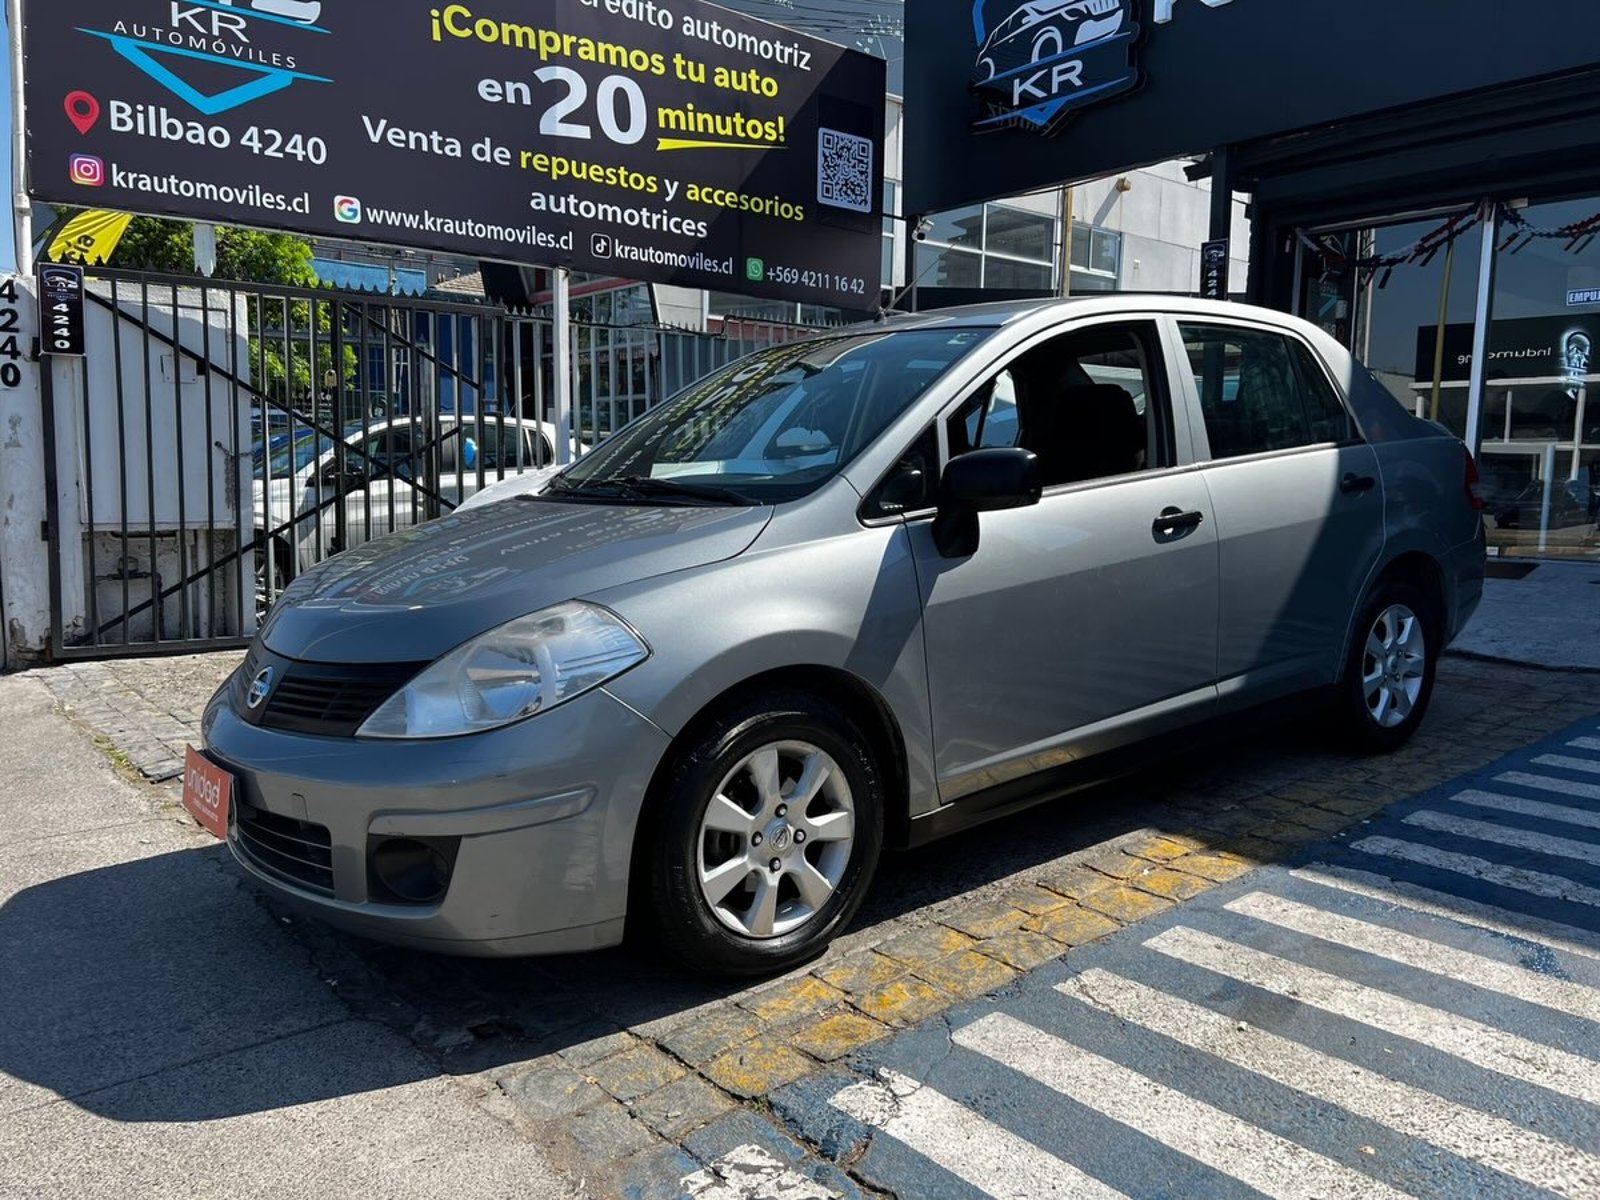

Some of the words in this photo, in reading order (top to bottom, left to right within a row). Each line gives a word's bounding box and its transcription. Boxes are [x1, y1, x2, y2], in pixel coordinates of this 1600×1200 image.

[113, 20, 297, 69] AUTOMÓVILES
[171, 1, 250, 44] KR
[580, 0, 674, 30] dito
[682, 15, 812, 71] automotriz
[430, 4, 666, 76] ¡Compramos
[673, 53, 706, 84] tu
[713, 66, 779, 98] auto
[477, 77, 532, 105] en
[533, 65, 648, 145] 20
[657, 103, 786, 142] minutos!
[1013, 59, 1083, 106] KR
[109, 99, 232, 149] Bilbao
[240, 126, 328, 165] 4240
[111, 163, 311, 215] krautomoviles.cl
[361, 115, 462, 158] Venta
[471, 137, 512, 166] de
[520, 150, 658, 194] repuestos
[664, 178, 680, 202] y
[686, 182, 805, 222] accesorios
[366, 207, 573, 251] www.krautomoviles.cl
[530, 191, 708, 239] automotrices
[615, 239, 733, 275] krautomoviles.cl
[1207, 269, 1219, 296] 424
[1569, 290, 1600, 303] EMPU
[52, 303, 71, 349] 4240
